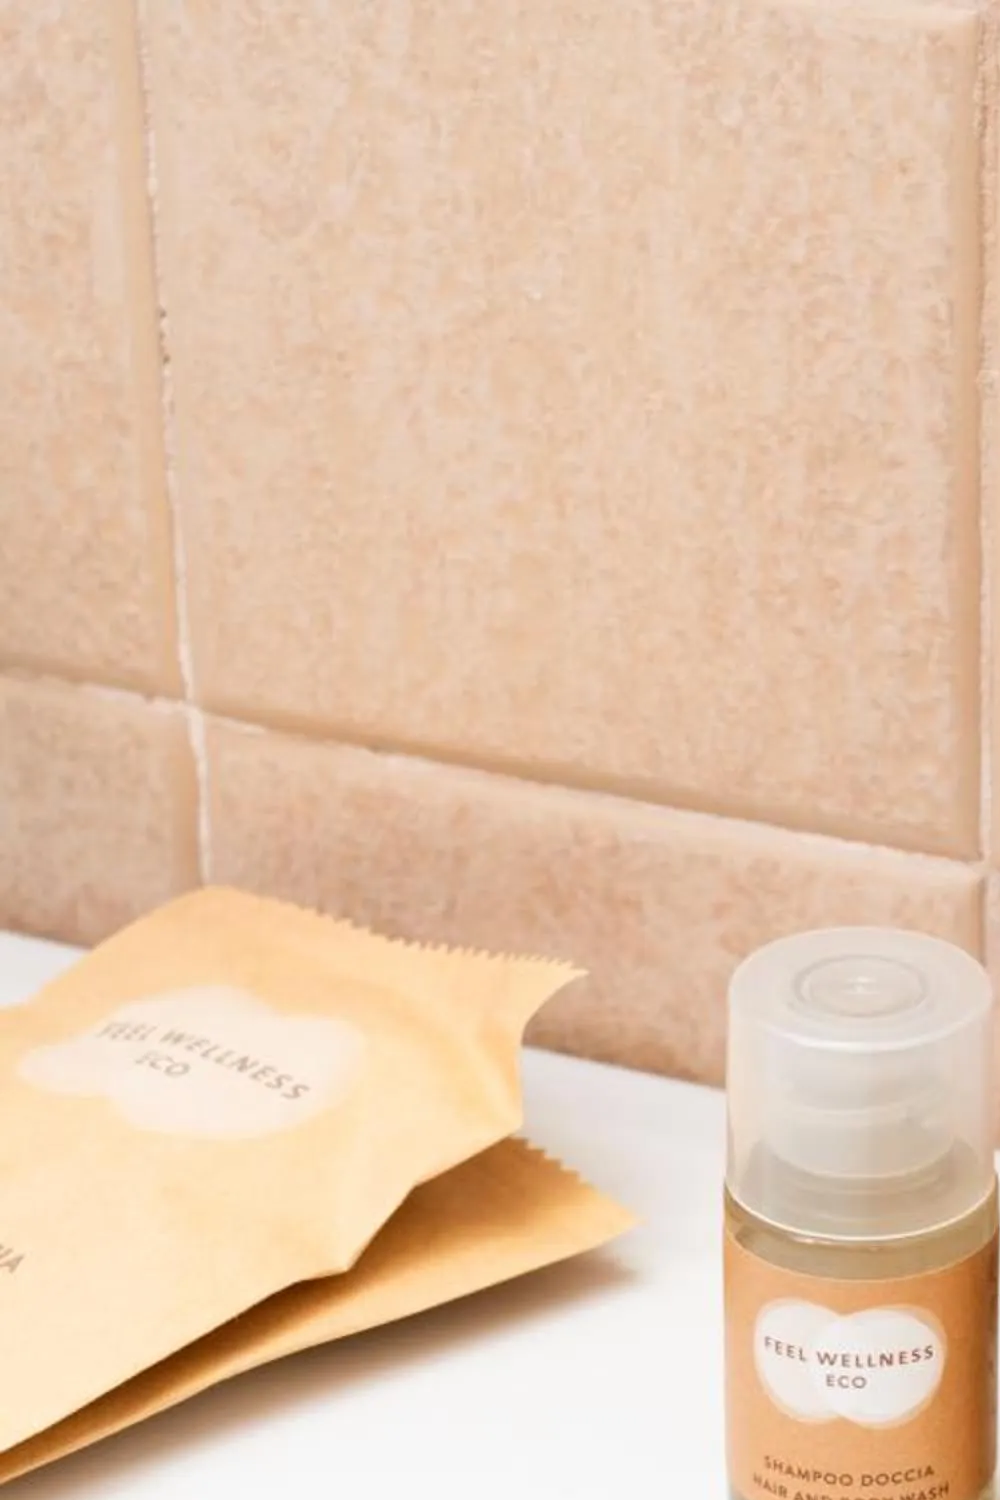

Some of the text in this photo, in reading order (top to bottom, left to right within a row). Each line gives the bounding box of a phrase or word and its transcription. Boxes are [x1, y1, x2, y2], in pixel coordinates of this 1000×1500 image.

[135, 1050, 191, 1077] ECO
[160, 1029, 309, 1099] WELLNESS
[764, 1335, 934, 1368] FEEL WELLNESS
[826, 1374, 868, 1389] ECO
[763, 1455, 935, 1487] SHAMPOO DOCCIA
[752, 1473, 788, 1499] HAIR
